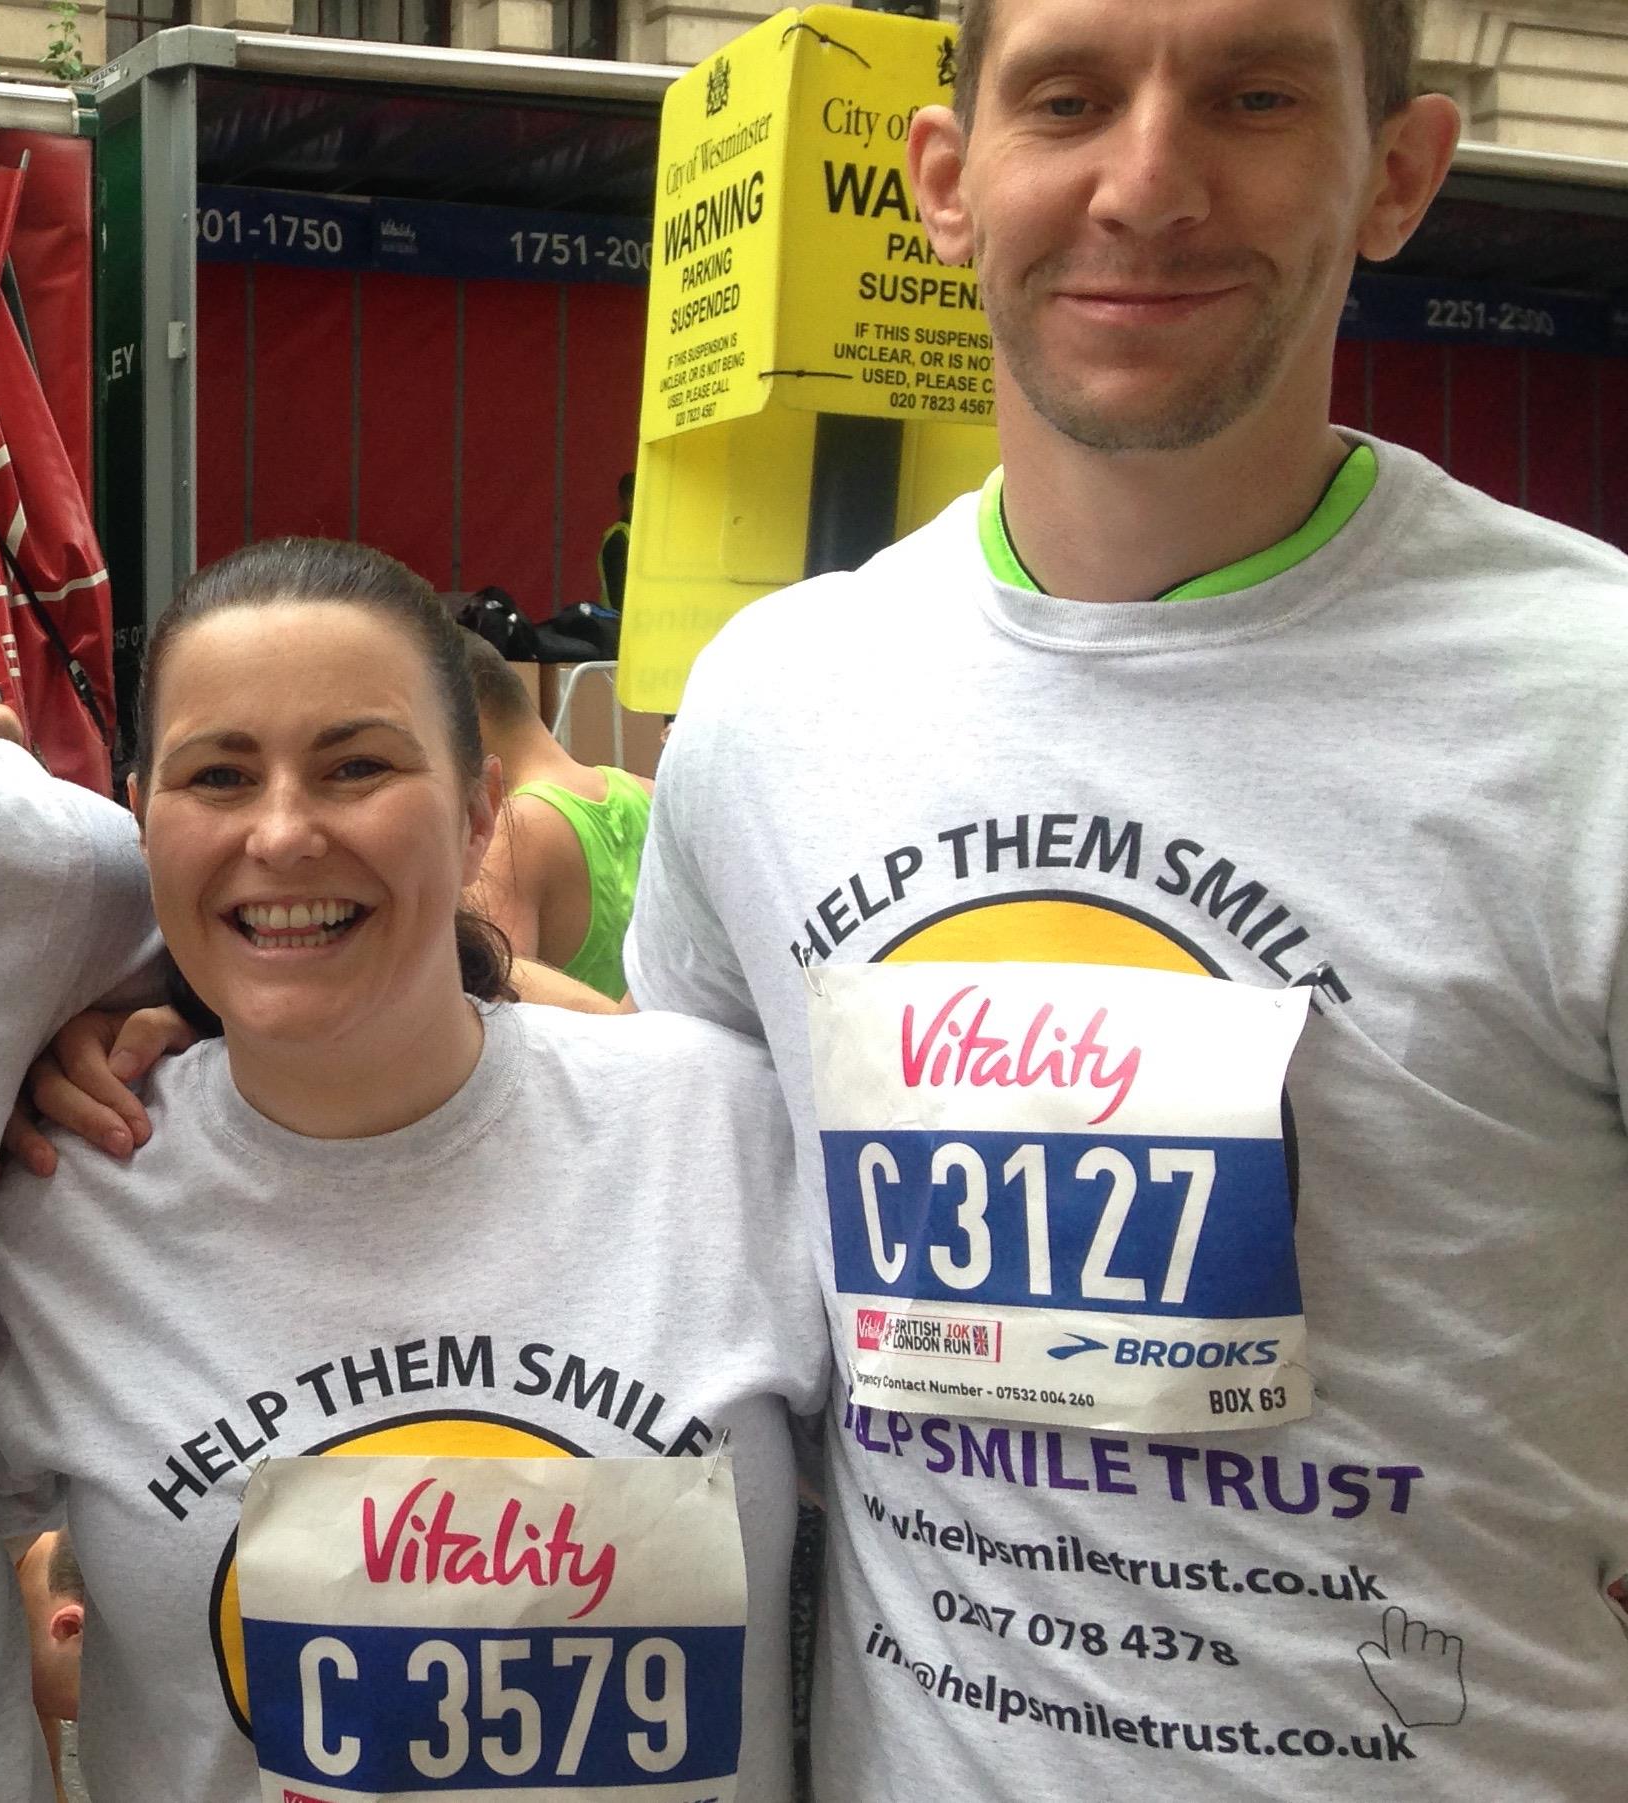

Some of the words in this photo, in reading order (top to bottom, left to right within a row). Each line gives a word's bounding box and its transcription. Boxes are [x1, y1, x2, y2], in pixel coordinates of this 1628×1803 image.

[823, 97, 880, 149] City
[666, 161, 685, 199] City
[686, 145, 699, 184] of
[700, 112, 772, 174] Westminster
[664, 170, 764, 266] WARNING
[681, 246, 732, 293] PARKING
[859, 272, 984, 311] SUSPEN
[670, 283, 740, 335] SUSPENDED
[855, 322, 870, 339] IF
[874, 323, 910, 342] THIS
[834, 343, 916, 367] UNCLEAR,
[920, 351, 944, 369] OR
[949, 354, 963, 370] IS
[967, 355, 995, 372] NO
[862, 368, 911, 389] USED,
[916, 372, 977, 393] PLEASE
[890, 392, 917, 409] 020
[921, 394, 955, 413] 7823
[959, 399, 995, 415] 4567
[790, 846, 924, 968] HELP
[937, 813, 1144, 880] THEM
[1155, 838, 1353, 1017] SMILE
[901, 984, 1142, 1126] Vitality
[857, 1141, 908, 1285] C
[929, 1142, 1218, 1304] 3127
[893, 1336, 941, 1353] LONDON
[943, 1339, 971, 1355] RUN
[895, 1319, 941, 1338] BRITISH
[946, 1323, 970, 1340] 10K
[1114, 1338, 1280, 1368] BROOKS
[883, 1374, 926, 1392] Contact
[929, 1380, 983, 1397] Number
[996, 1386, 1038, 1402] 07532
[1040, 1390, 1066, 1405] 004
[1069, 1393, 1095, 1408] 260
[1209, 1388, 1254, 1415] BOX
[1260, 1386, 1287, 1411] 63
[146, 1390, 289, 1522] HELP
[296, 1335, 496, 1417] THEM
[513, 1343, 715, 1457] SMILE
[921, 1417, 1138, 1496] SMILE
[1148, 1443, 1427, 1520] TRUST
[362, 1478, 617, 1620] Vitality
[932, 1589, 1016, 1638] 0207
[1028, 1613, 1108, 1655] 078
[1120, 1623, 1239, 1667] 4378
[298, 1636, 361, 1777] C
[406, 1636, 688, 1780] 3579
